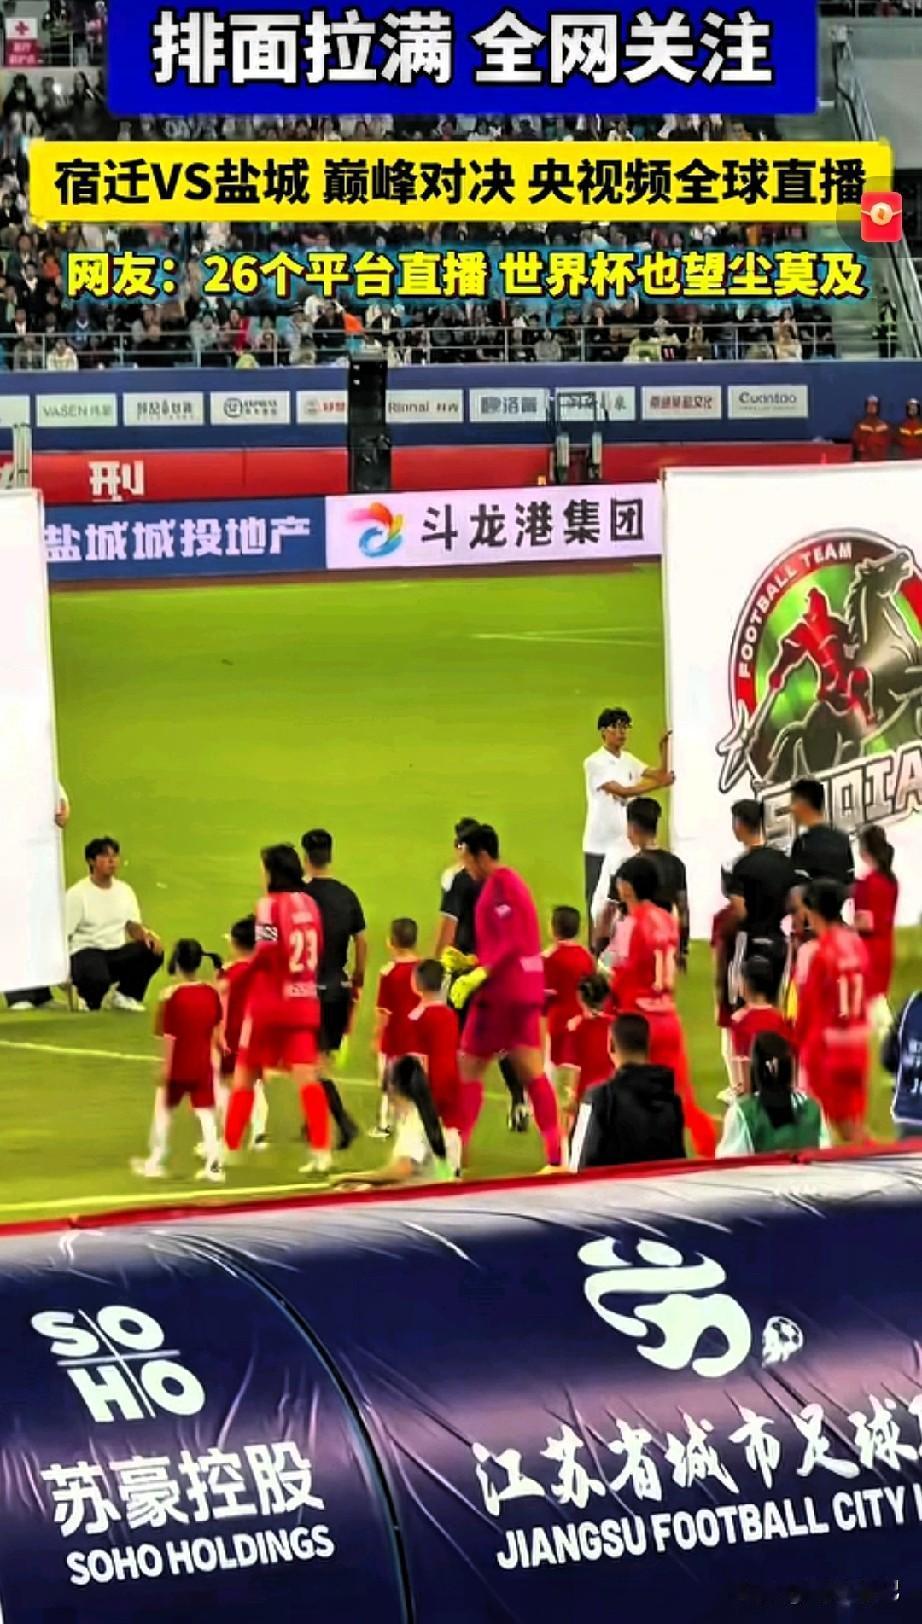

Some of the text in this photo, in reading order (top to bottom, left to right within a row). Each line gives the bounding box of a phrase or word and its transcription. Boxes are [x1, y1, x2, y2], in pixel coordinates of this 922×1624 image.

[44, 515, 310, 562] 盐城城投地产
[421, 498, 644, 551] 斗龙港集团
[738, 542, 852, 678] FOOTBALL TEAM
[289, 928, 318, 974] 23
[40, 1441, 325, 1538] 苏豪控股
[471, 1393, 922, 1516] 江苏省城市足球
[66, 1524, 335, 1586] SOHO HOLDINGS
[496, 1514, 647, 1569] JIANGSU
[650, 1495, 830, 1552] FOOTBALL
[831, 1484, 907, 1531] CITY
